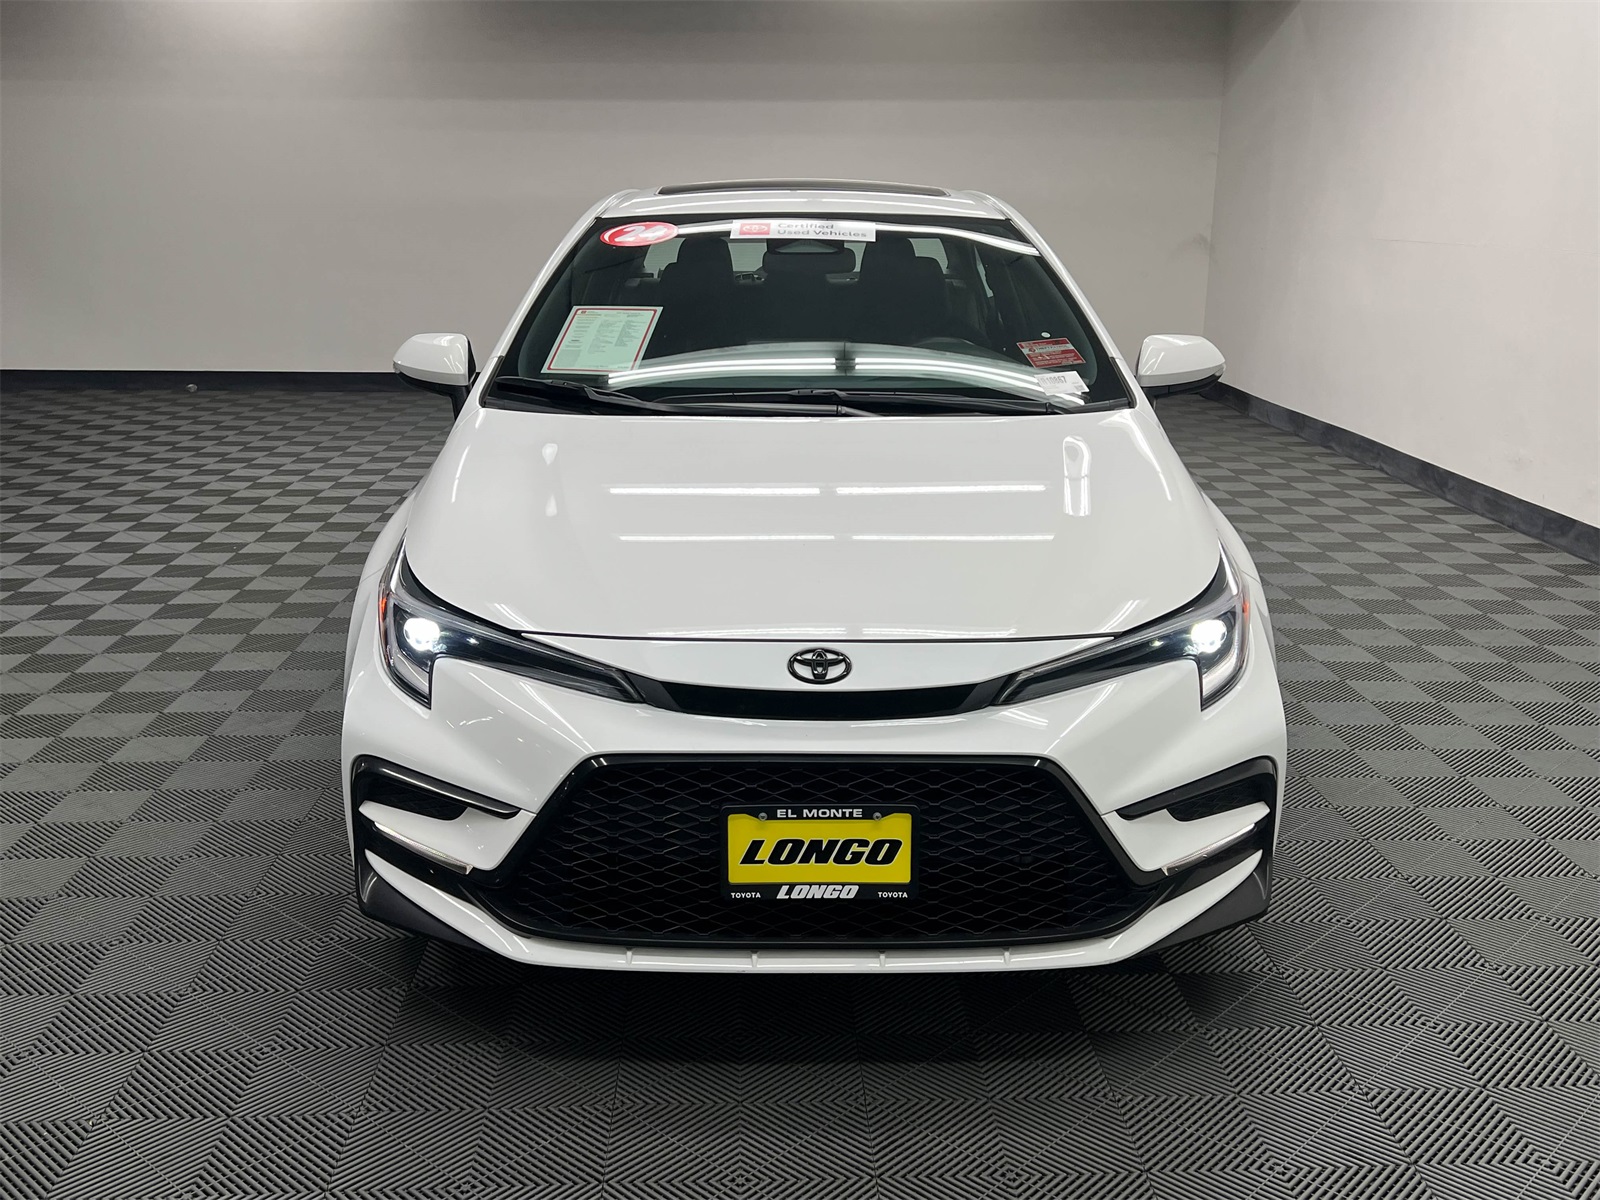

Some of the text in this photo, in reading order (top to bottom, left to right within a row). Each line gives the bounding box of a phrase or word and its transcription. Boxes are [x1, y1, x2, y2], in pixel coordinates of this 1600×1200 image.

[777, 222, 834, 230] Certified
[614, 225, 667, 242] 24
[813, 229, 867, 238] Vehicles
[776, 808, 863, 818] EL MONTE
[739, 838, 903, 866] LONGO
[731, 891, 761, 899] TOYOTA
[776, 884, 859, 899] LONGO
[878, 891, 908, 899] TOYOTA
